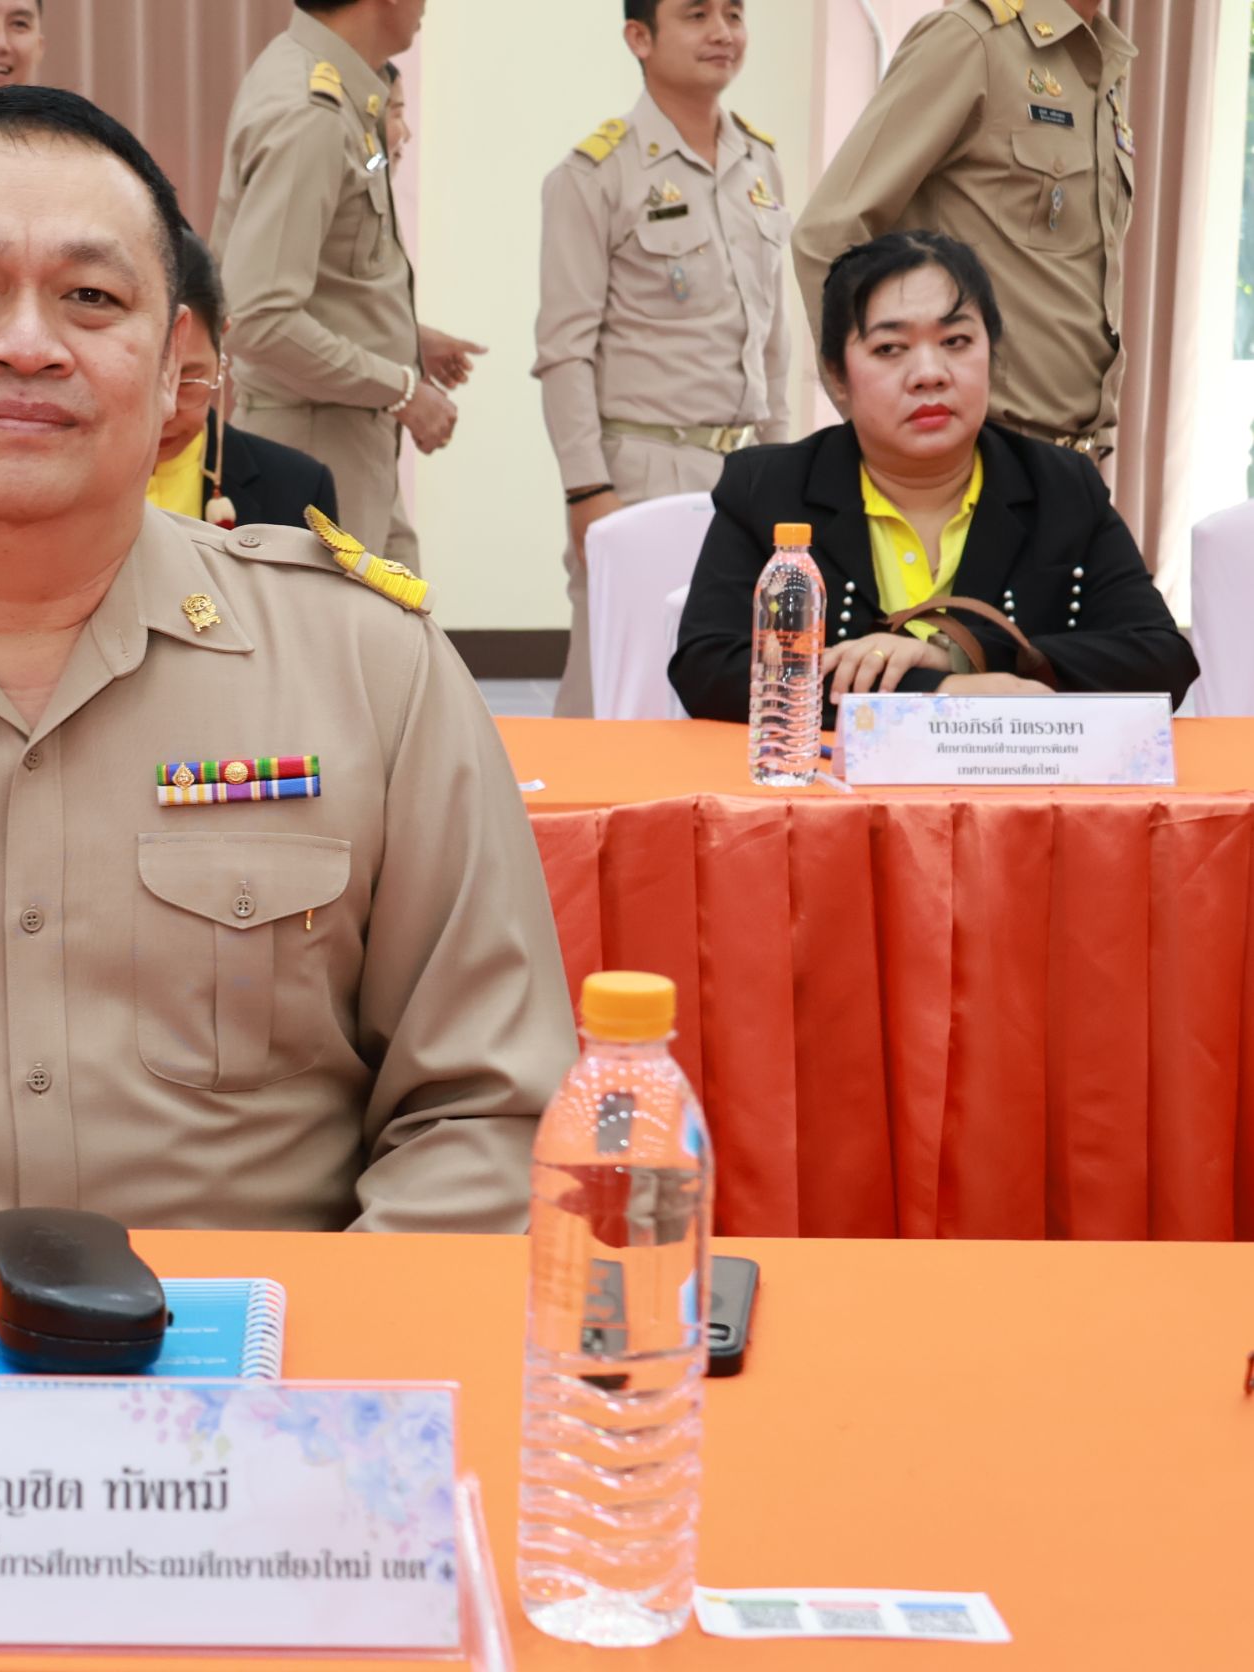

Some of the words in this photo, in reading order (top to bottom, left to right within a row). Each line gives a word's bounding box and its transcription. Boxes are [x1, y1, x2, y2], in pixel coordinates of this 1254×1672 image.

[102, 1466, 228, 1511] ทัพหมี
[381, 1558, 427, 1580] เขต
